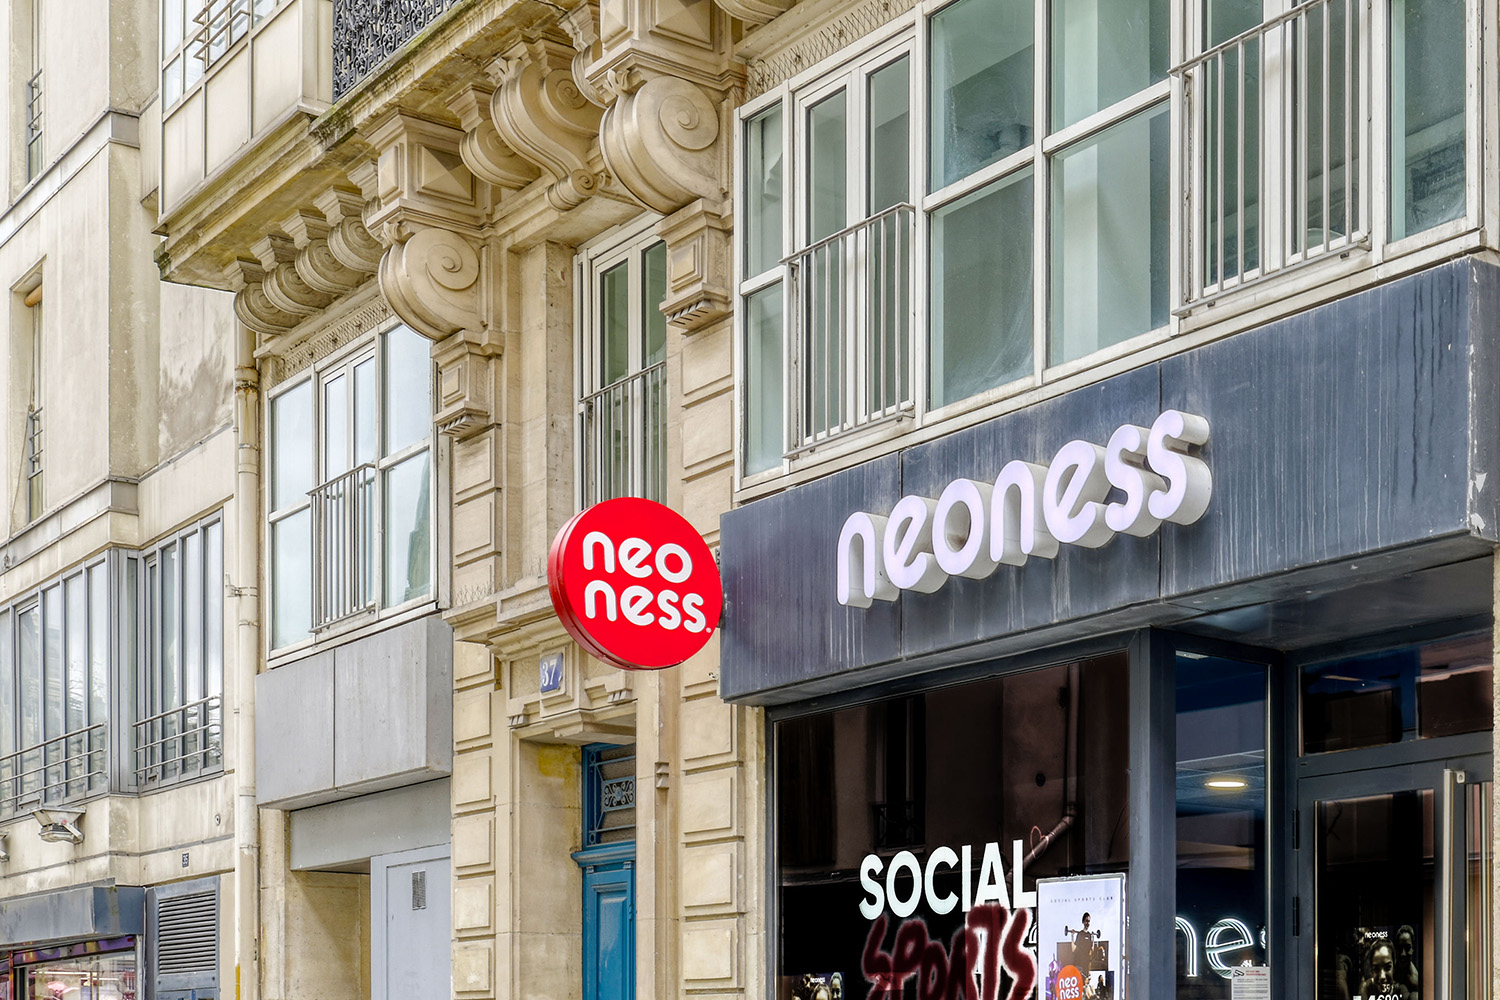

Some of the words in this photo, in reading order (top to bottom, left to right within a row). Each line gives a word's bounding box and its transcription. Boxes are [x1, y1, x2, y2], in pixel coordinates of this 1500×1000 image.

[837, 409, 1212, 607] neoness
[582, 531, 693, 585] neo
[542, 658, 557, 687] 37
[859, 839, 1037, 920] SOCIAL
[1059, 976, 1077, 989] neo
[1060, 986, 1079, 1000] ness
